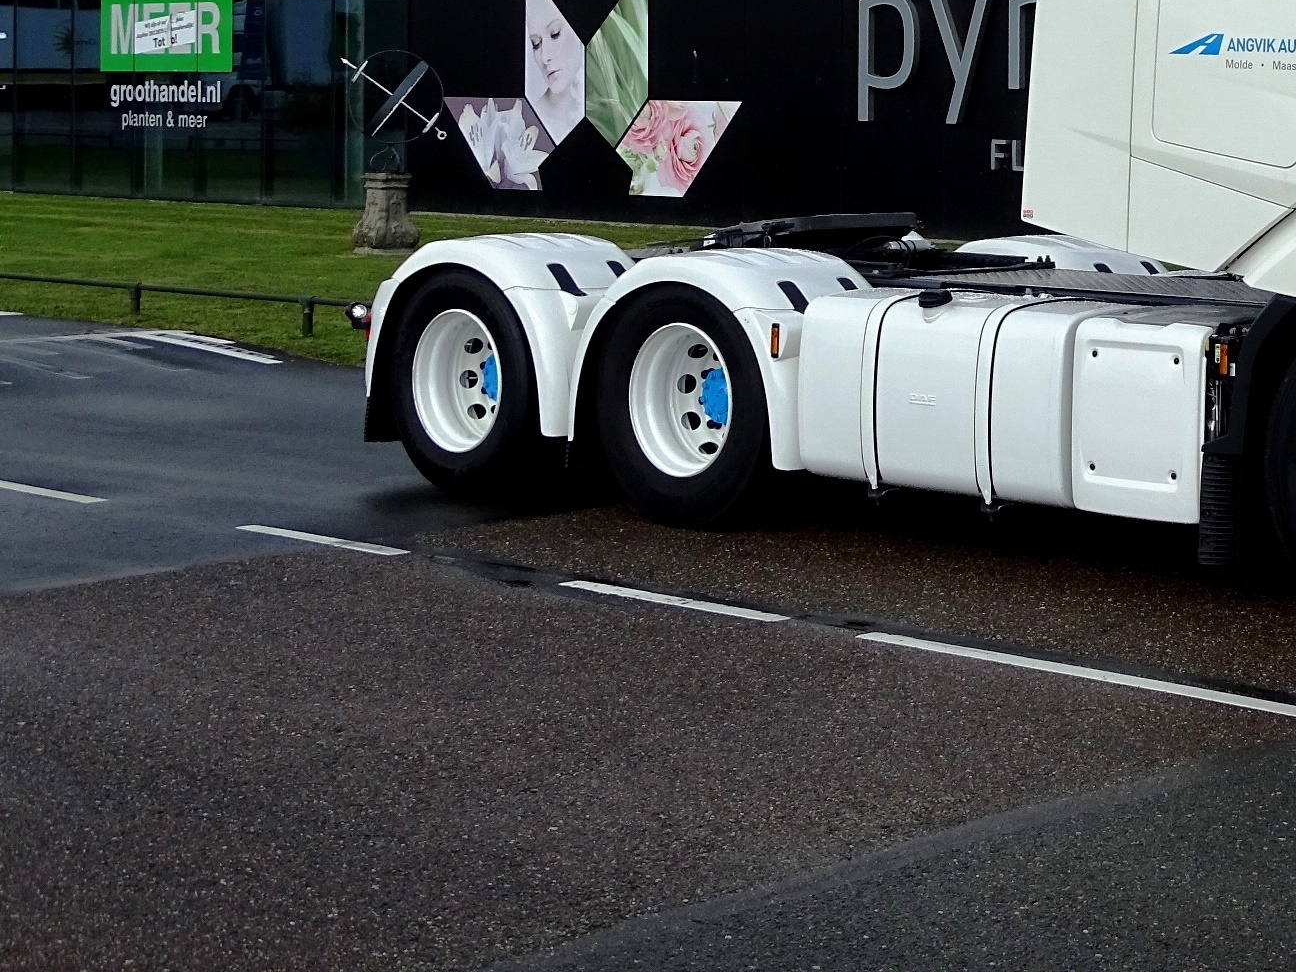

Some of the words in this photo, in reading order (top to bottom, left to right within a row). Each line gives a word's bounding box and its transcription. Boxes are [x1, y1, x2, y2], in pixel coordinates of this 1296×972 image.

[1226, 37, 1276, 53] ANGVIK
[1225, 59, 1253, 70] Molde
[110, 80, 221, 107] groothandel.nl
[121, 110, 163, 130] planten
[166, 110, 175, 127] &
[178, 114, 208, 128] meer
